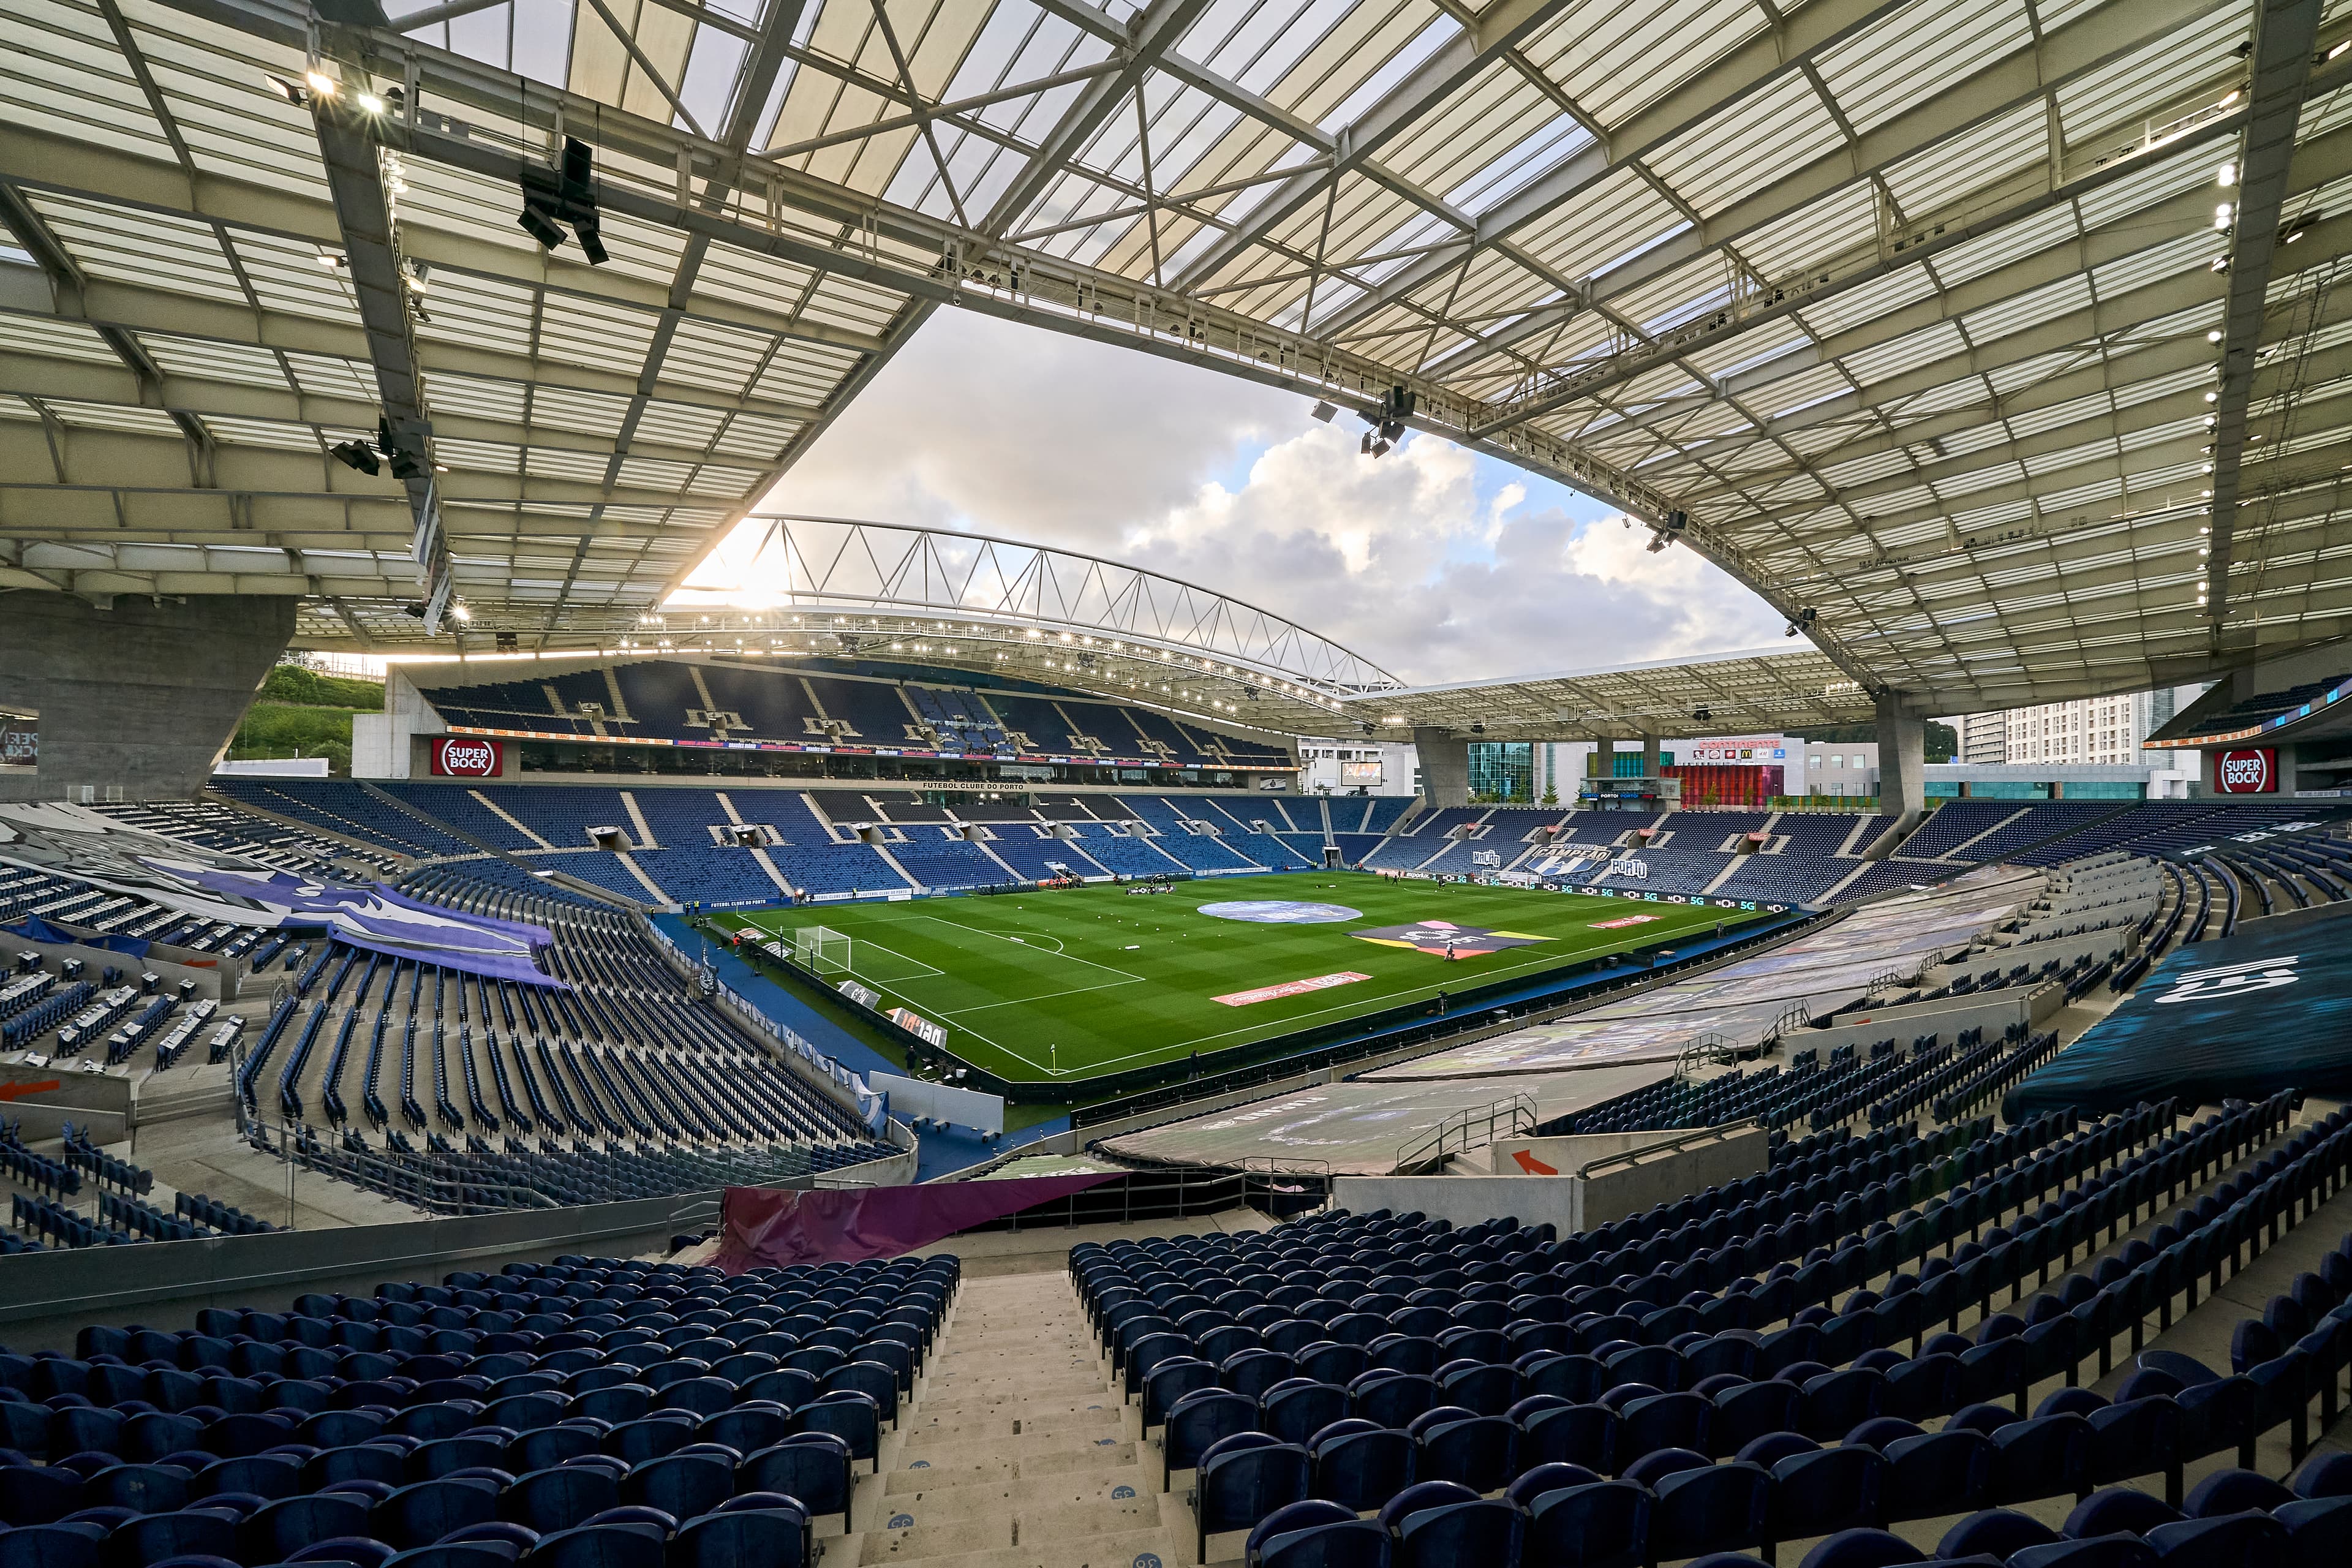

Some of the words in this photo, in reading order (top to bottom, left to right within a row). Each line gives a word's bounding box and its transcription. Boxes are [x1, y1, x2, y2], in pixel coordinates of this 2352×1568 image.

[1700, 740, 1780, 749] CONTINENTE
[448, 747, 488, 759] SUPER
[450, 758, 486, 769] BOCK
[2226, 760, 2261, 772] SUPER
[2228, 771, 2259, 784] BOCK
[1473, 850, 1500, 867] NAÇÃO
[1611, 859, 1647, 878] PORTO
[1668, 895, 1686, 903] NOS
[1716, 899, 1735, 908] NOS
[1740, 901, 1755, 910] 5G
